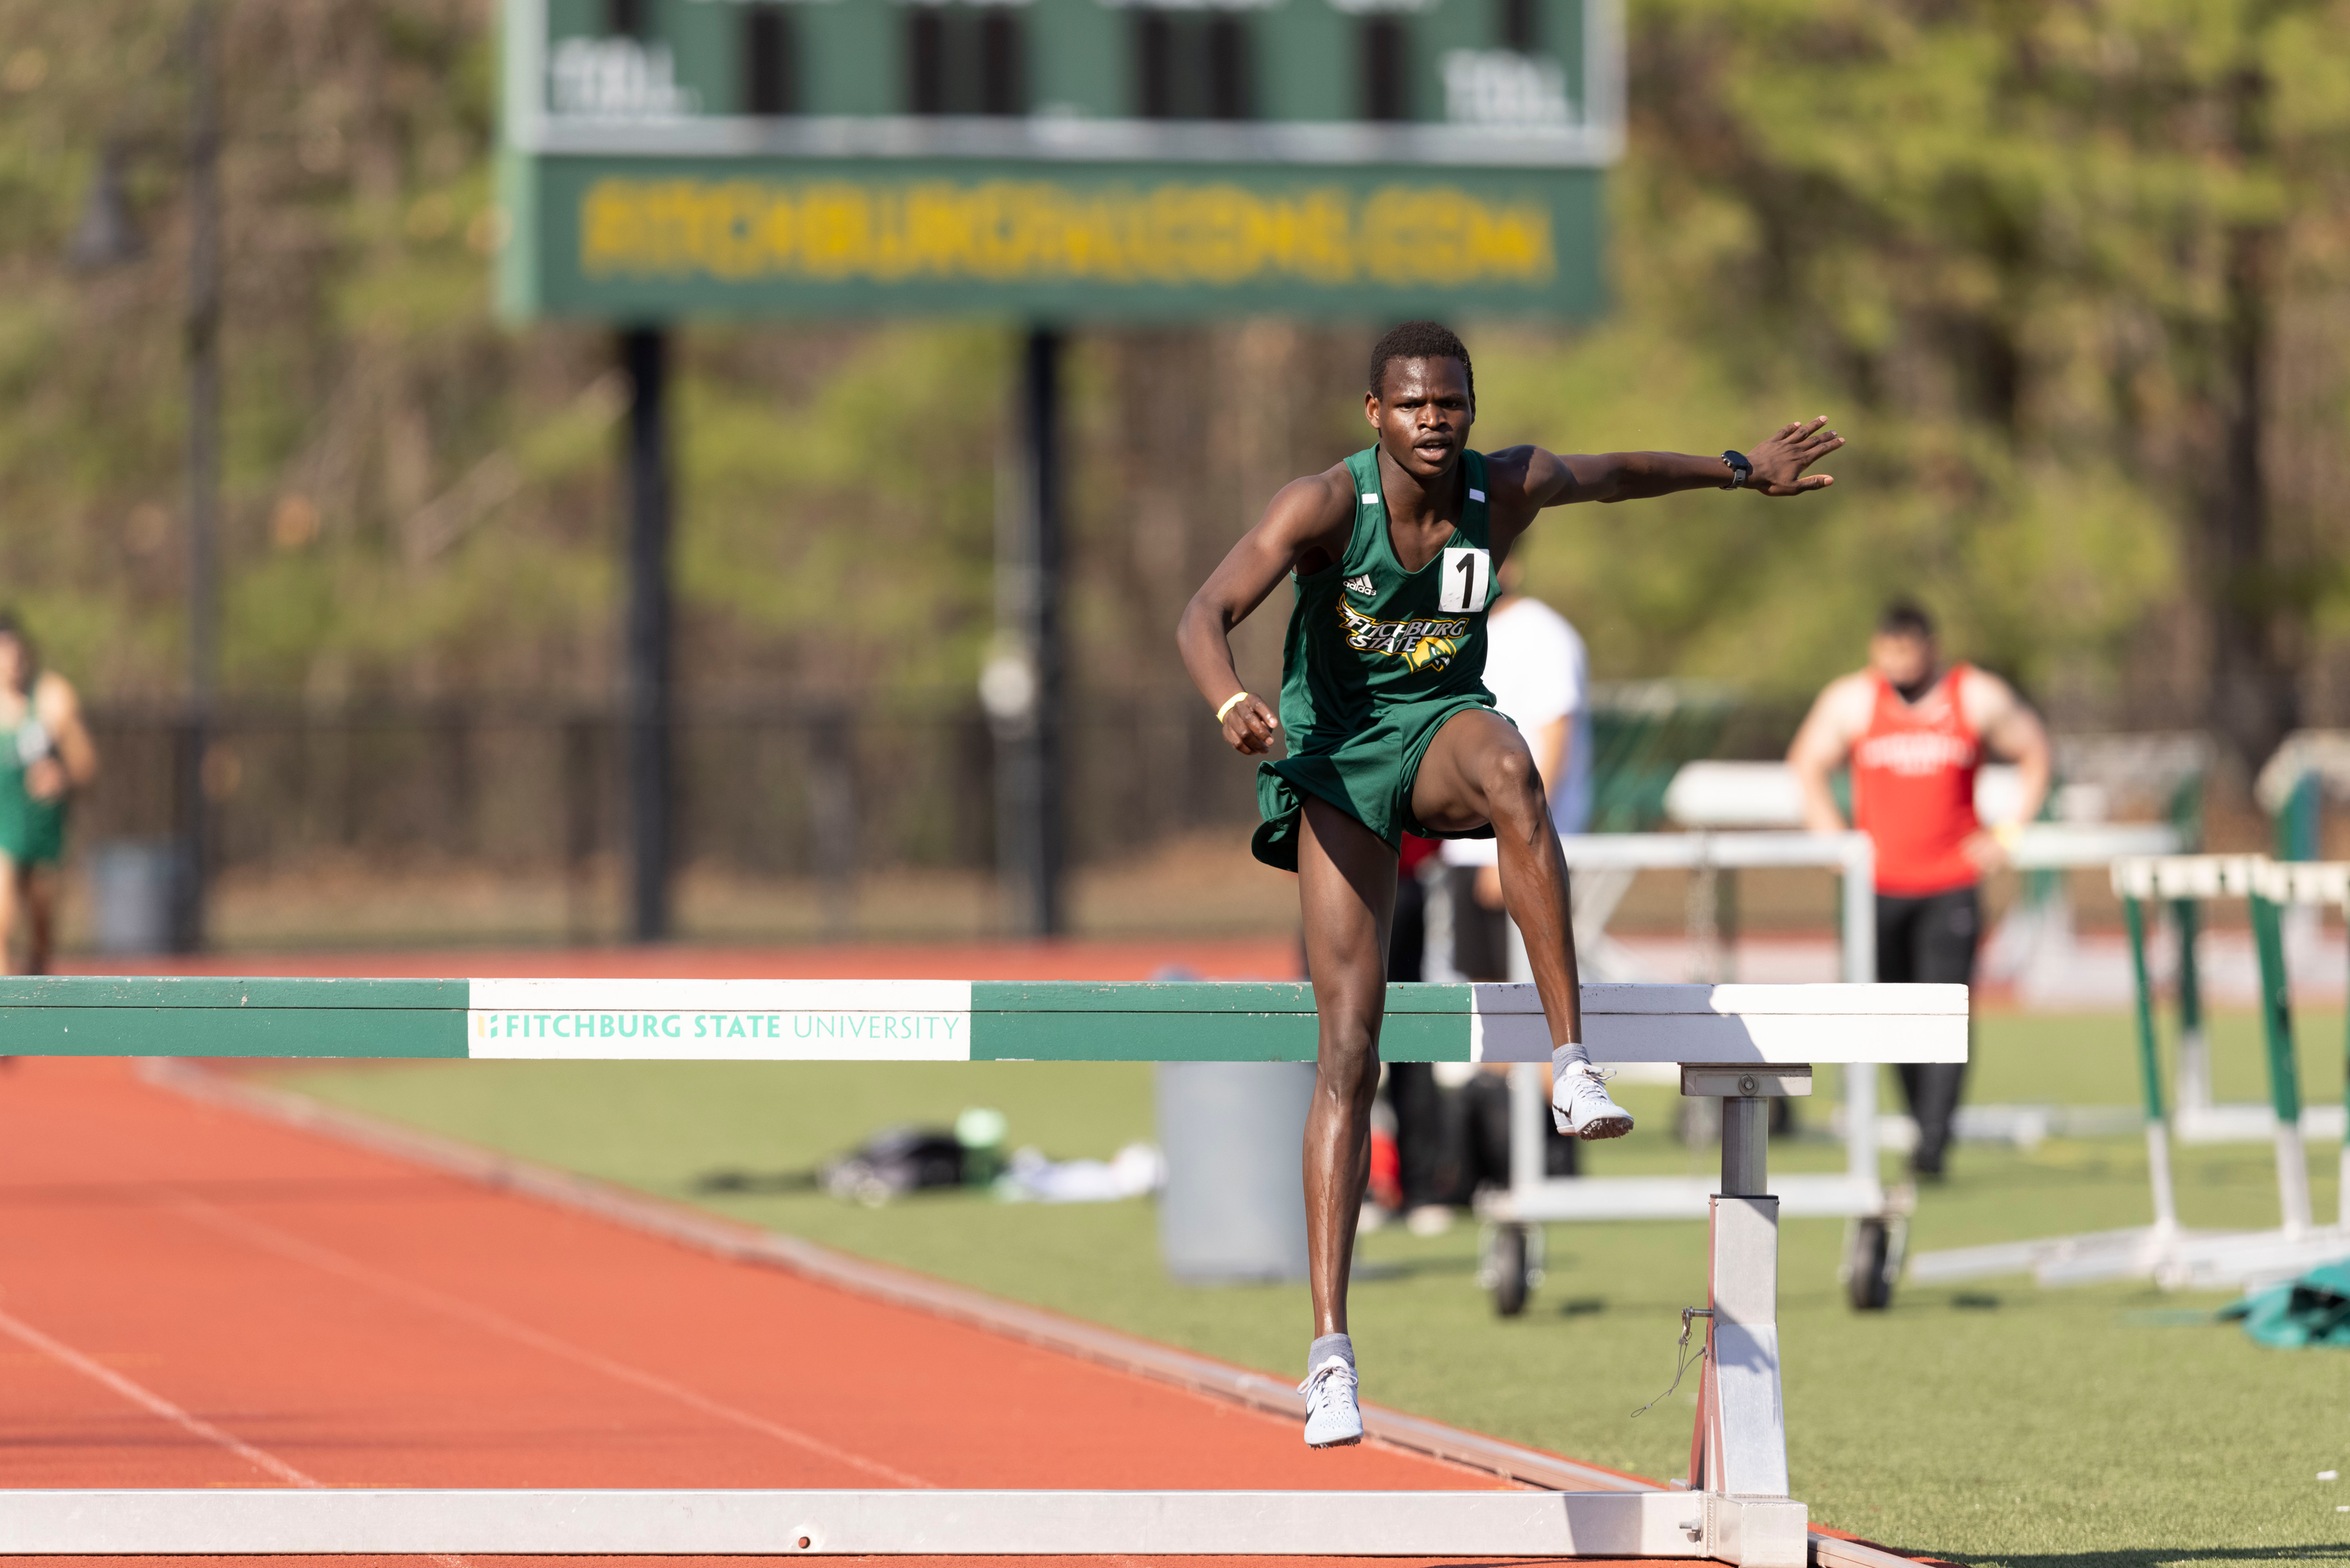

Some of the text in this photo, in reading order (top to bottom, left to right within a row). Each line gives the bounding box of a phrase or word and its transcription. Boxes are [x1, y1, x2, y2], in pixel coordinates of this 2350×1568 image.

[1343, 581, 1377, 596] adidas
[1456, 553, 1475, 609] 1
[1344, 616, 1466, 639] FITCHBURG
[1349, 635, 1421, 653] STATE
[506, 1014, 959, 1039] FITCHBURG STATE UNIVERSITY
